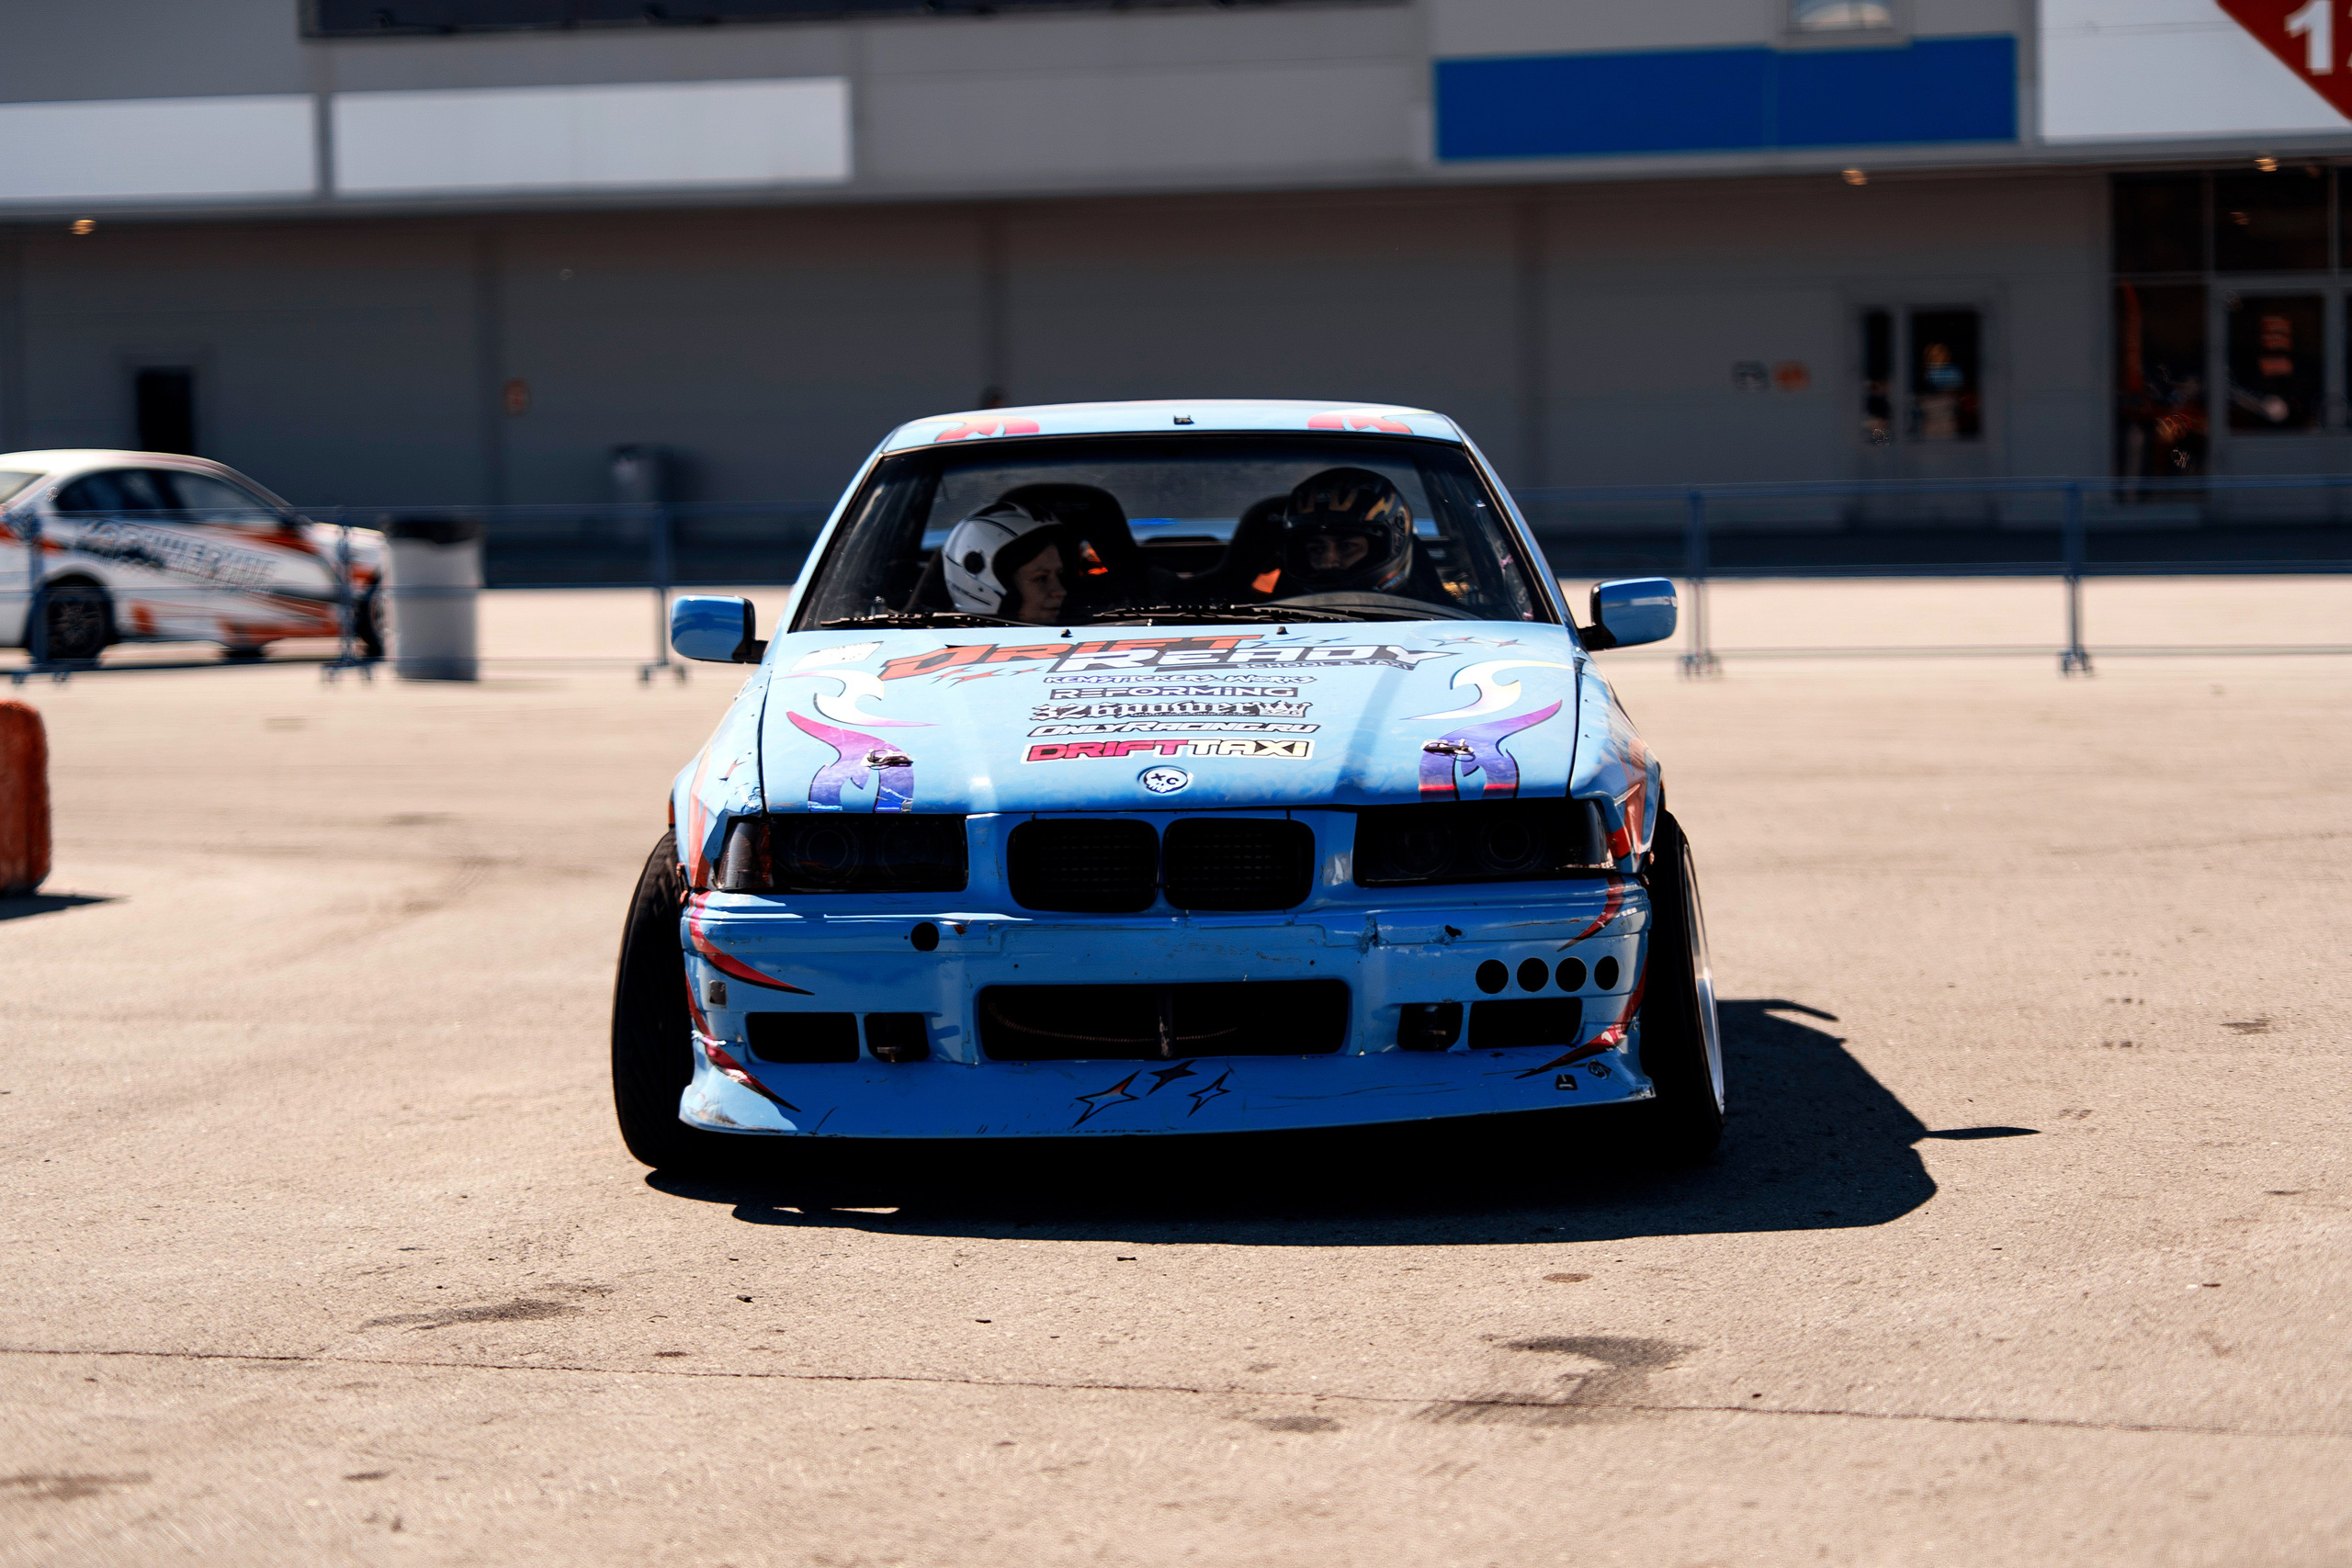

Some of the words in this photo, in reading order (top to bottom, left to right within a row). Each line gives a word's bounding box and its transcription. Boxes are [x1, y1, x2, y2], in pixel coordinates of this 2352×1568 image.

[2283, 0, 2352, 75] 1
[878, 635, 1264, 681] DRIFT
[1049, 645, 1461, 673] READY
[1237, 661, 1332, 670] SCHOOL
[1361, 660, 1408, 671] TAXI
